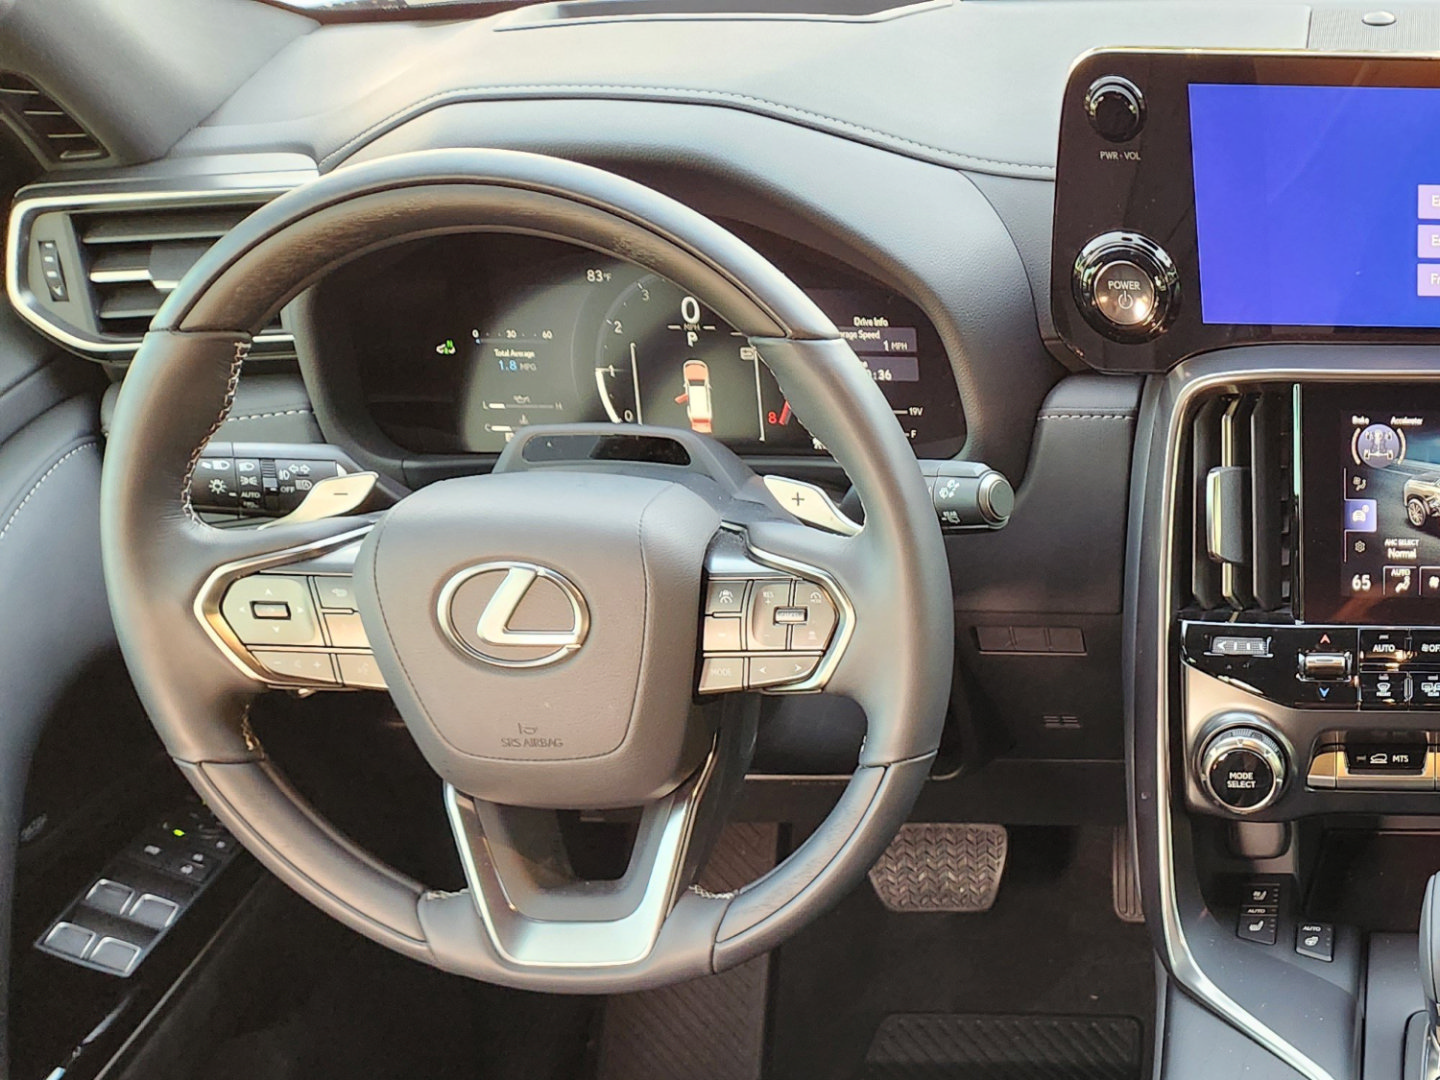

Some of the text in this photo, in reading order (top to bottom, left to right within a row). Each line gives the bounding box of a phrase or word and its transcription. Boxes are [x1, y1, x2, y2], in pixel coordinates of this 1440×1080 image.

[1107, 280, 1141, 291] POWER
[680, 295, 701, 324] 0
[853, 316, 889, 328] Drive Info
[613, 321, 623, 334] 2
[472, 328, 480, 338] 0
[505, 329, 518, 339] 30
[541, 330, 553, 340] 60
[858, 330, 881, 341] Speed
[686, 332, 698, 347] P
[891, 341, 908, 351] MPH
[498, 359, 518, 372] 1.8
[767, 411, 778, 425] 8
[240, 491, 261, 499] AUTO
[1387, 548, 1417, 559] Normal
[1391, 568, 1411, 577] AUTO
[1351, 574, 1372, 591] 65
[1372, 643, 1396, 653] AUTO
[1228, 771, 1254, 780] MODE
[1226, 780, 1257, 789] SELECT
[1302, 925, 1322, 933] AUTO
